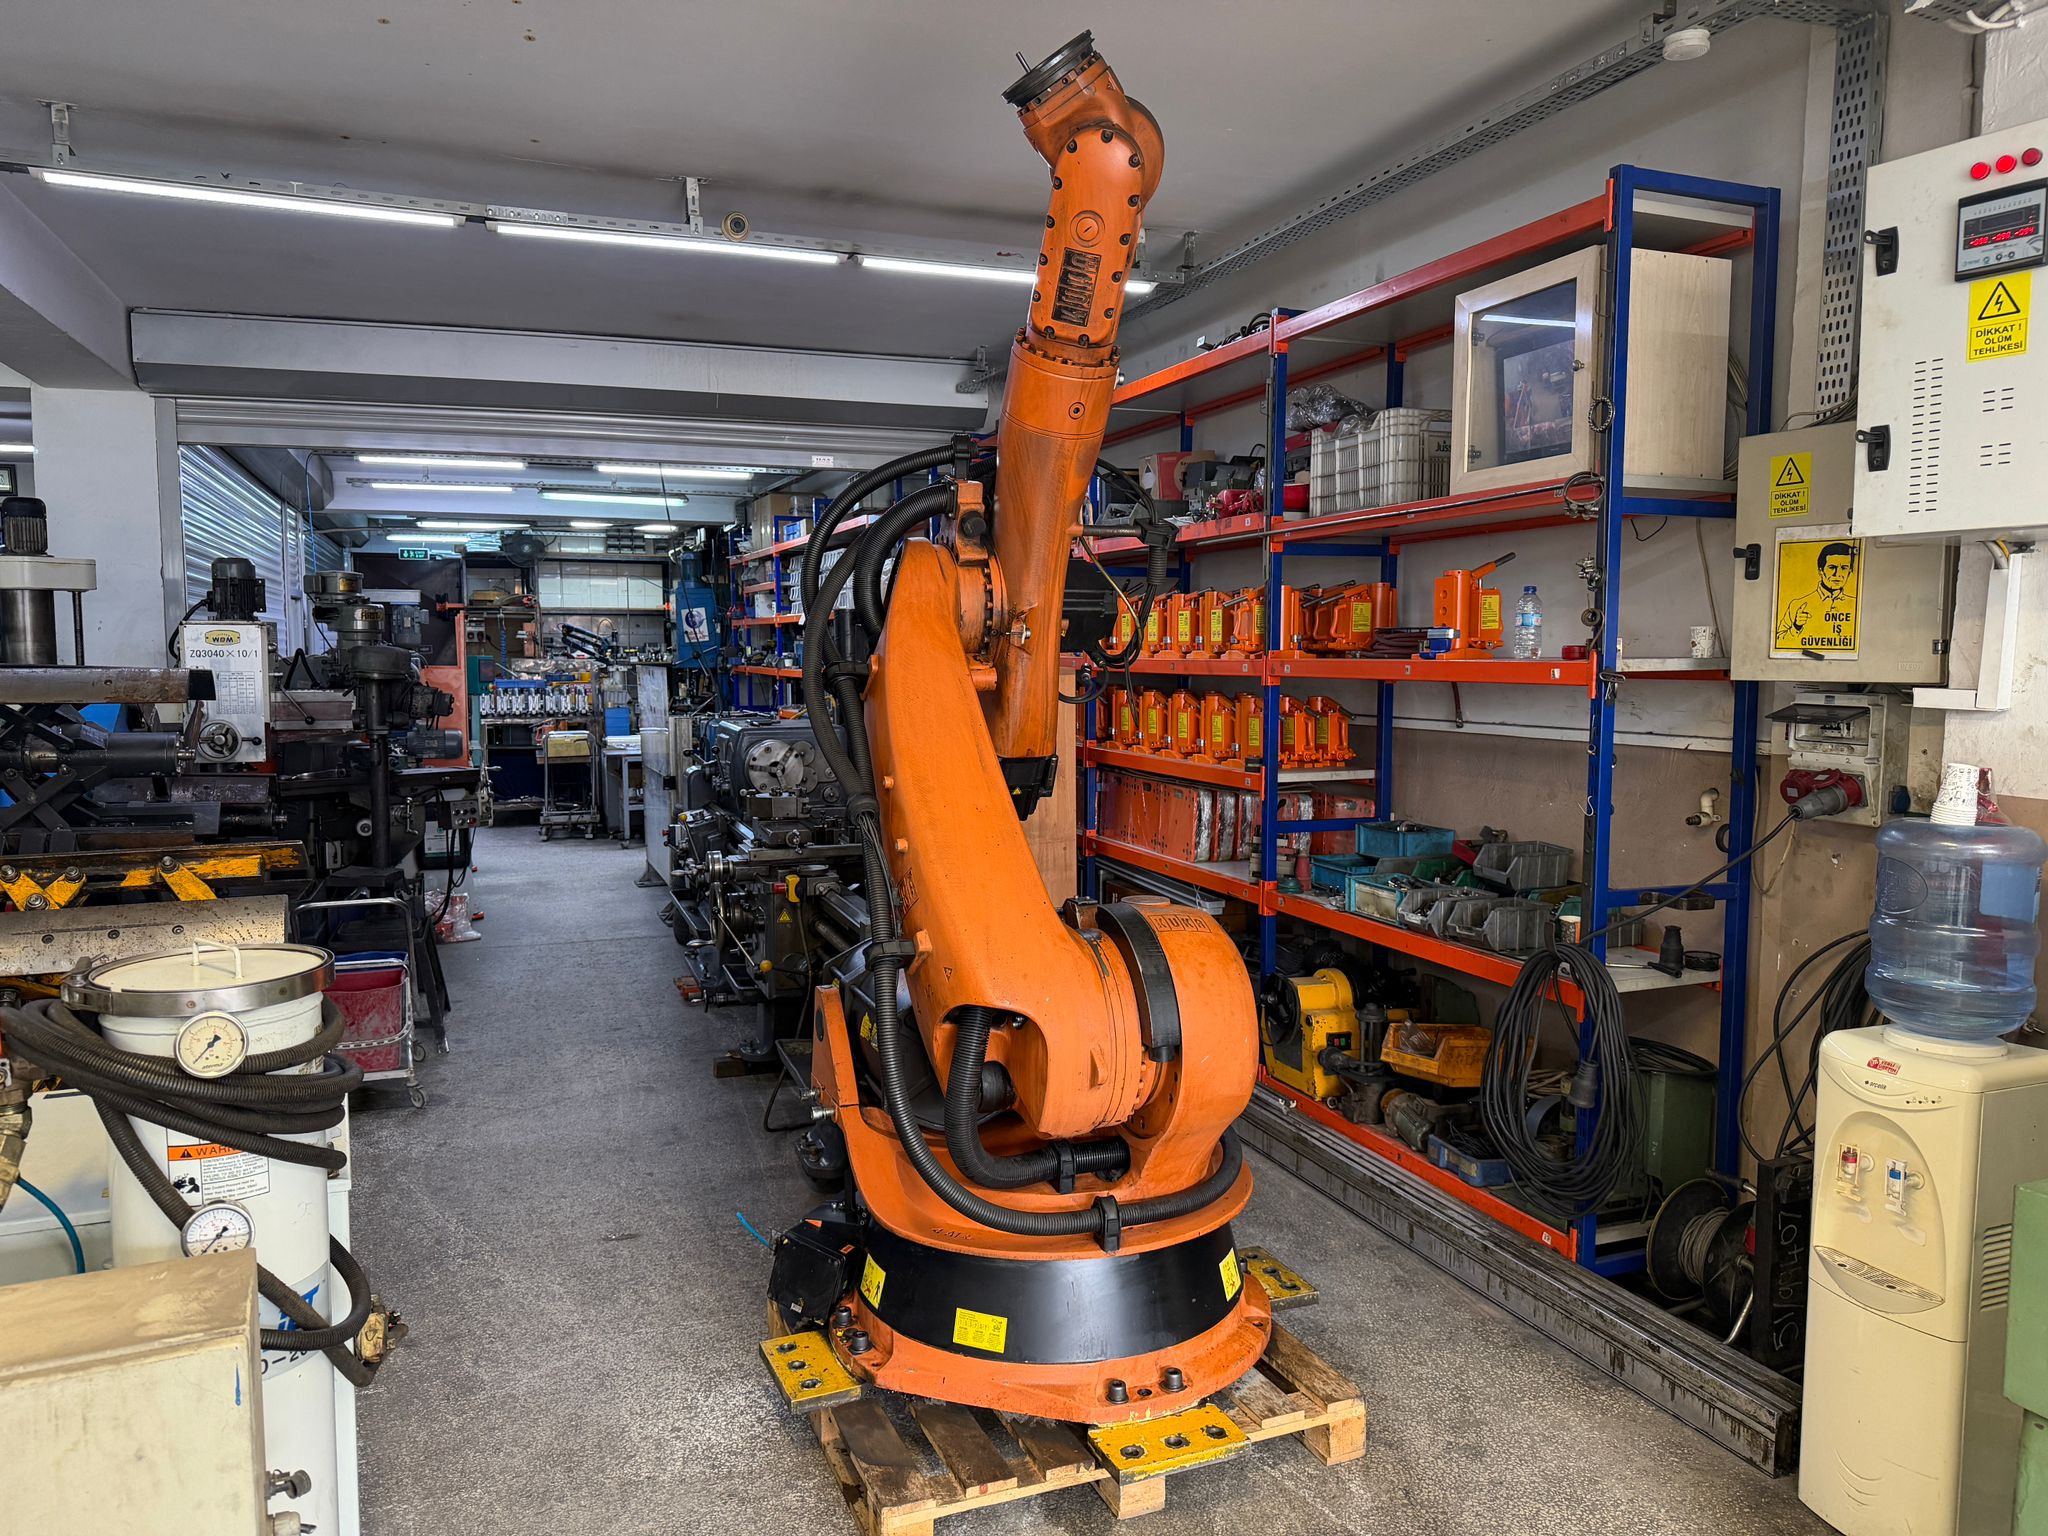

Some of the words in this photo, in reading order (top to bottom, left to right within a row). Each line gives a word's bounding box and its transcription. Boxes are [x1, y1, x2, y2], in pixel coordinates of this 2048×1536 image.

[1975, 323, 2016, 338] DİKKAT
[1984, 334, 2012, 346] ÖLÜM
[1974, 340, 2023, 356] TEHLİKESİ
[1774, 490, 1801, 500] DİKKAT
[1773, 503, 1806, 514] TEHLİKESİ
[1824, 611, 1851, 622] ÖNCE
[1832, 622, 1842, 636] İŞ
[1801, 635, 1852, 646] GÜVENLİĞİ
[1154, 917, 1206, 929] KUKA
